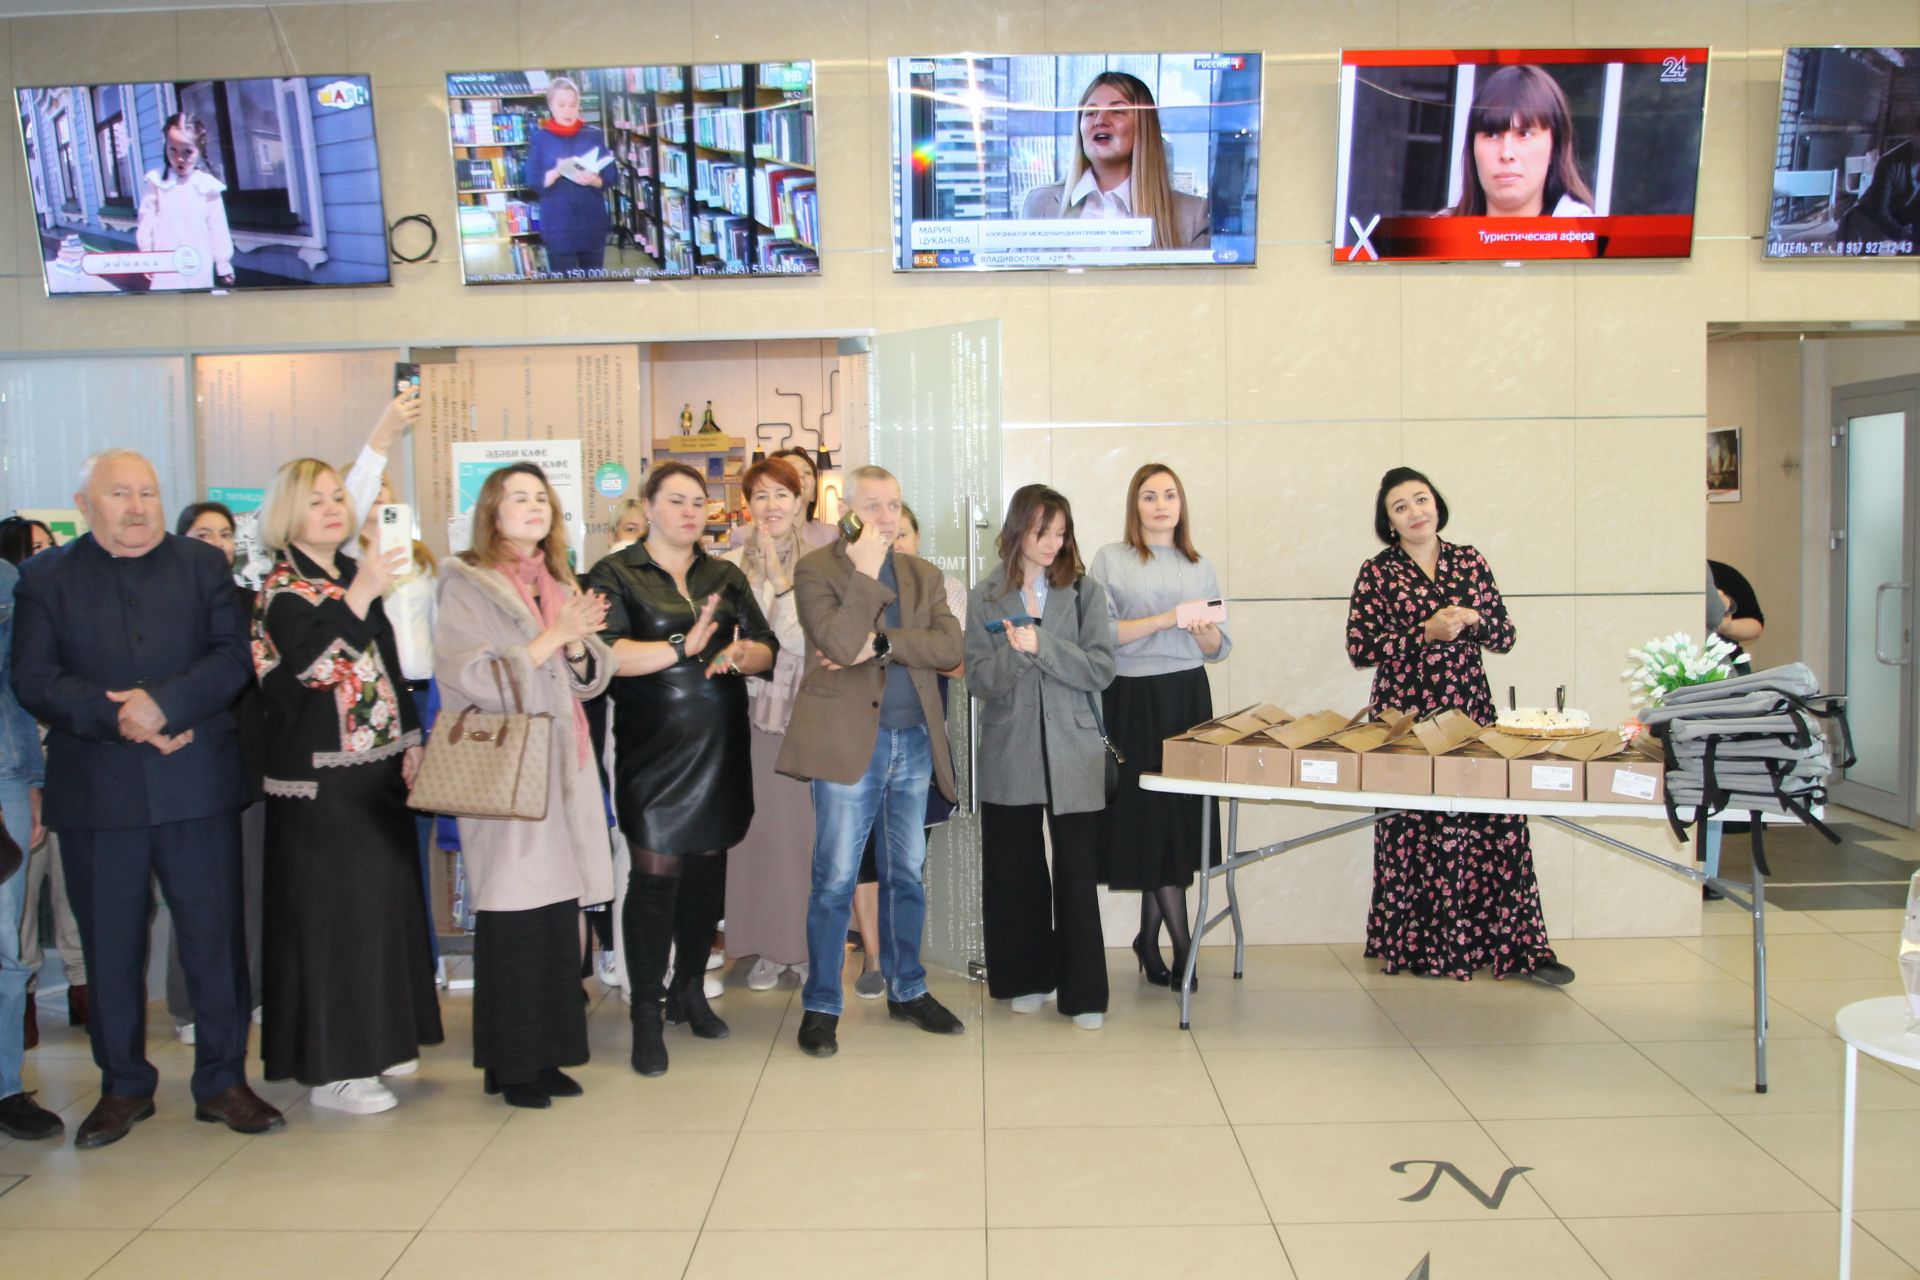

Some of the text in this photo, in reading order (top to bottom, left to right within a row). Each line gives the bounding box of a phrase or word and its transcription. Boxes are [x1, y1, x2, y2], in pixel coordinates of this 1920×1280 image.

[1661, 56, 1688, 77] 24
[919, 226, 952, 234] МАРИЯ
[919, 237, 970, 245] ЦУКАНОВА
[1478, 231, 1595, 244] Туристическая афера
[1836, 242, 1842, 254] 8
[1846, 242, 1863, 254] 917
[914, 256, 933, 264] 8:52
[981, 255, 1041, 263] ВЛАДИВОСТОК
[566, 268, 586, 279] 150
[588, 268, 608, 278] 000
[521, 448, 548, 458] КАФЕ
[542, 460, 569, 469] КАФЕ
[1390, 1160, 1535, 1209] N
